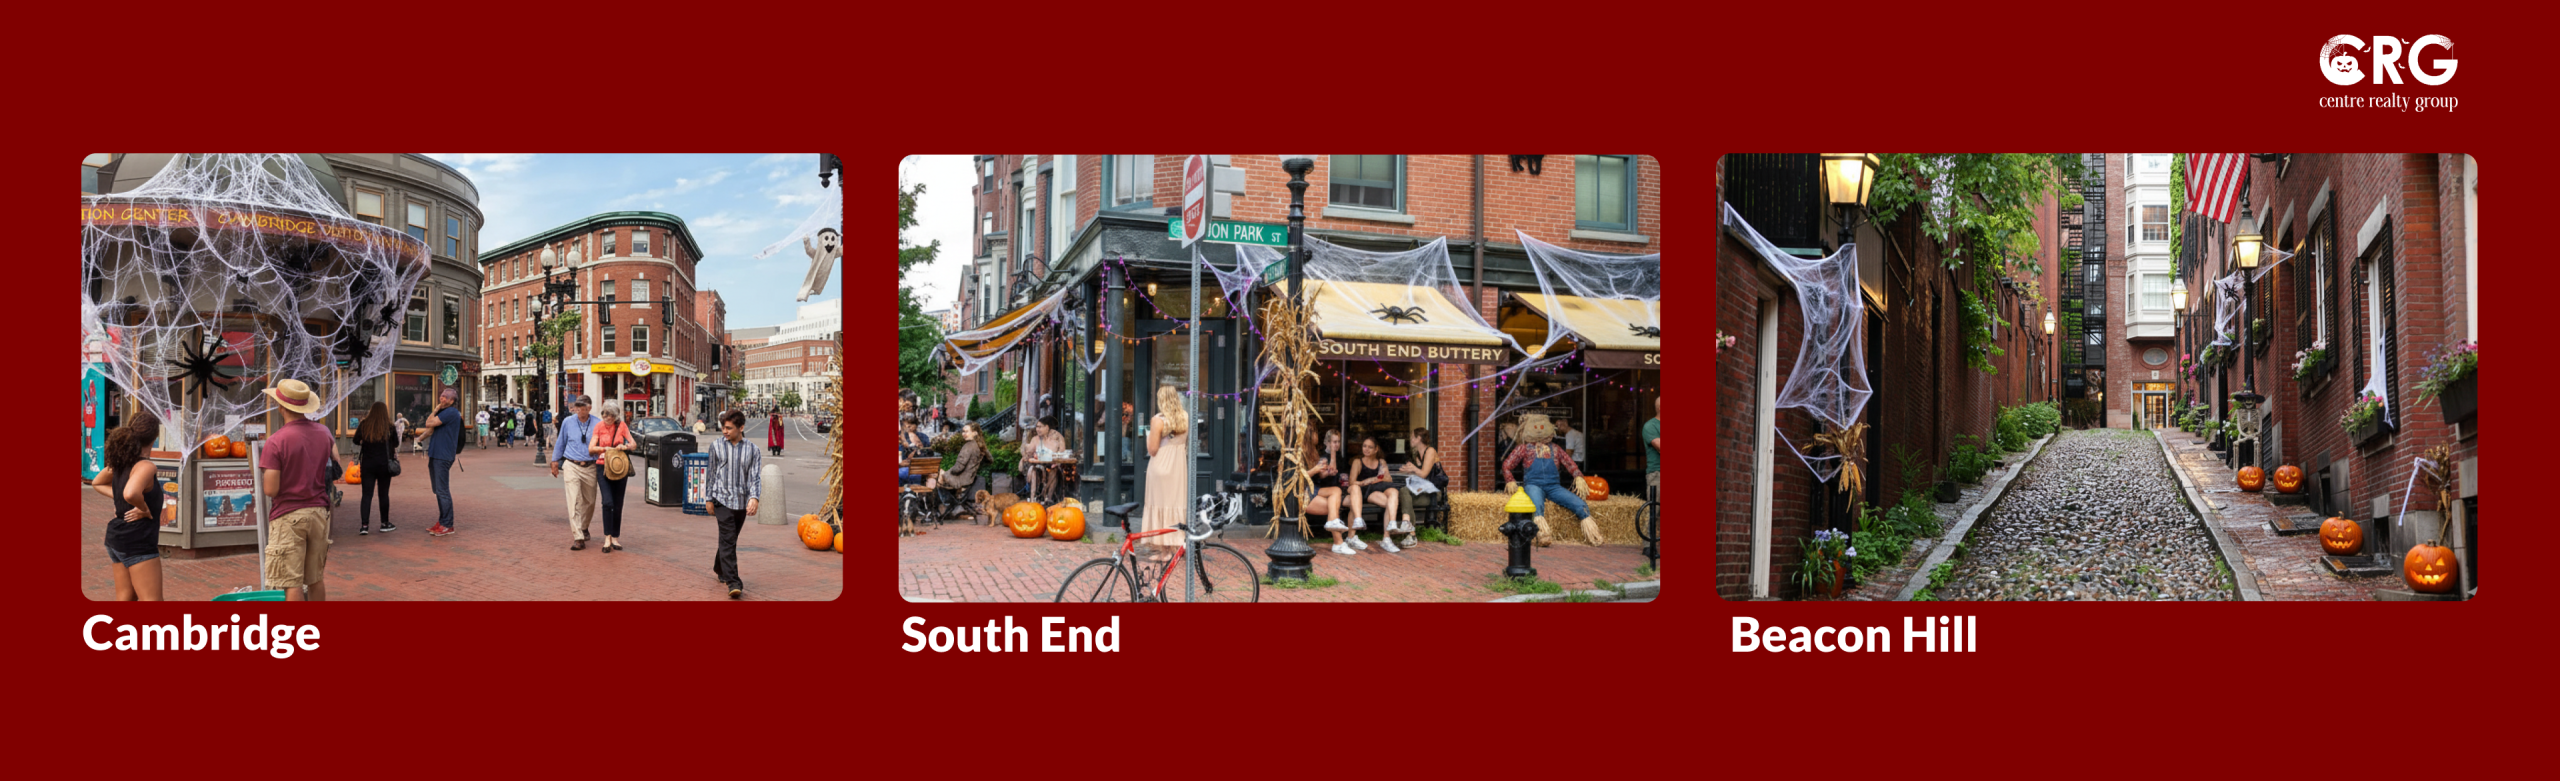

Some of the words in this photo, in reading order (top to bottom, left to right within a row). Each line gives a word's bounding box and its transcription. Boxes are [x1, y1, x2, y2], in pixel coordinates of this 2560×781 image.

[1233, 224, 1264, 242] PARK
[1271, 232, 1282, 243] ST
[1318, 342, 1380, 357] SOUTH
[1387, 344, 1422, 358] END
[1428, 346, 1503, 361] BUTTERY
